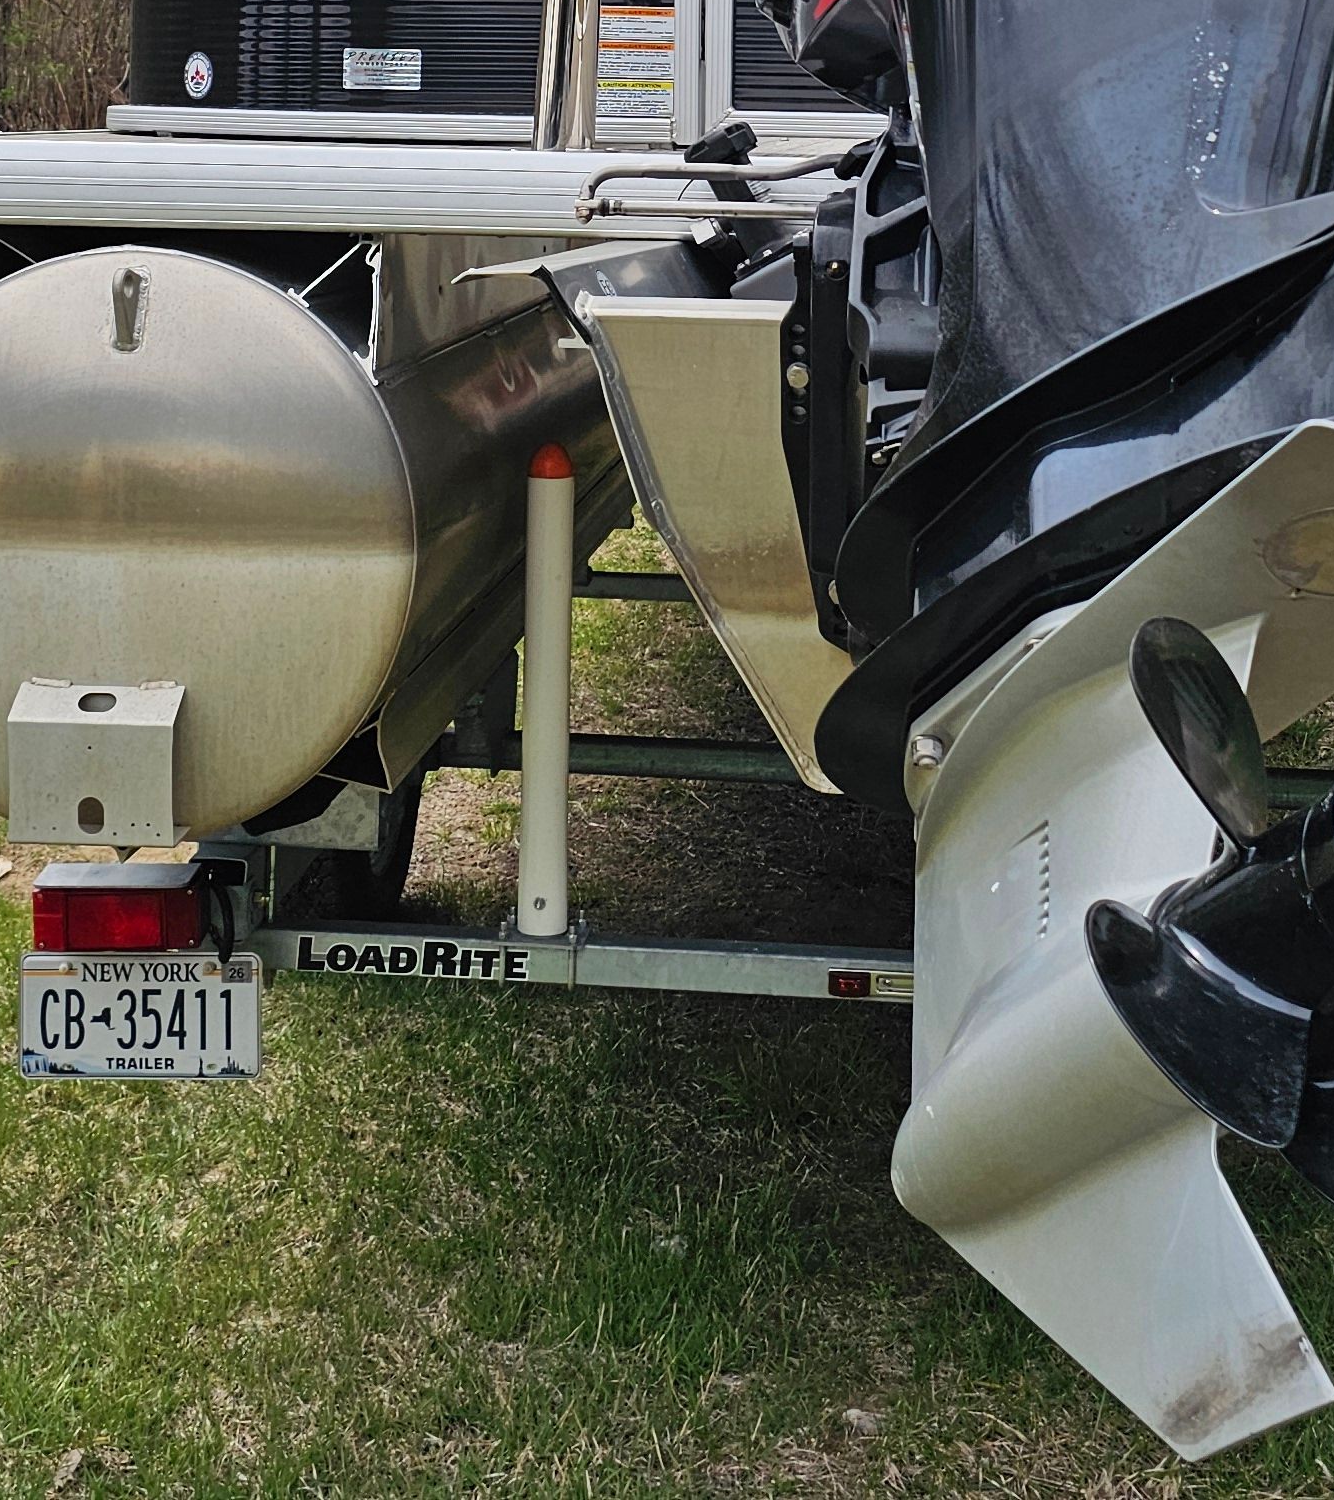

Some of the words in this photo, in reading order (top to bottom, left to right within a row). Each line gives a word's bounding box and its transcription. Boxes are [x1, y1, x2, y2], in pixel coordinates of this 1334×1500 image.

[81, 962, 135, 982] NEW
[139, 962, 201, 982] YORK
[228, 967, 245, 979] 26
[40, 988, 86, 1050] CB
[116, 988, 232, 1050] 35411
[105, 1057, 175, 1070] TRAILER
